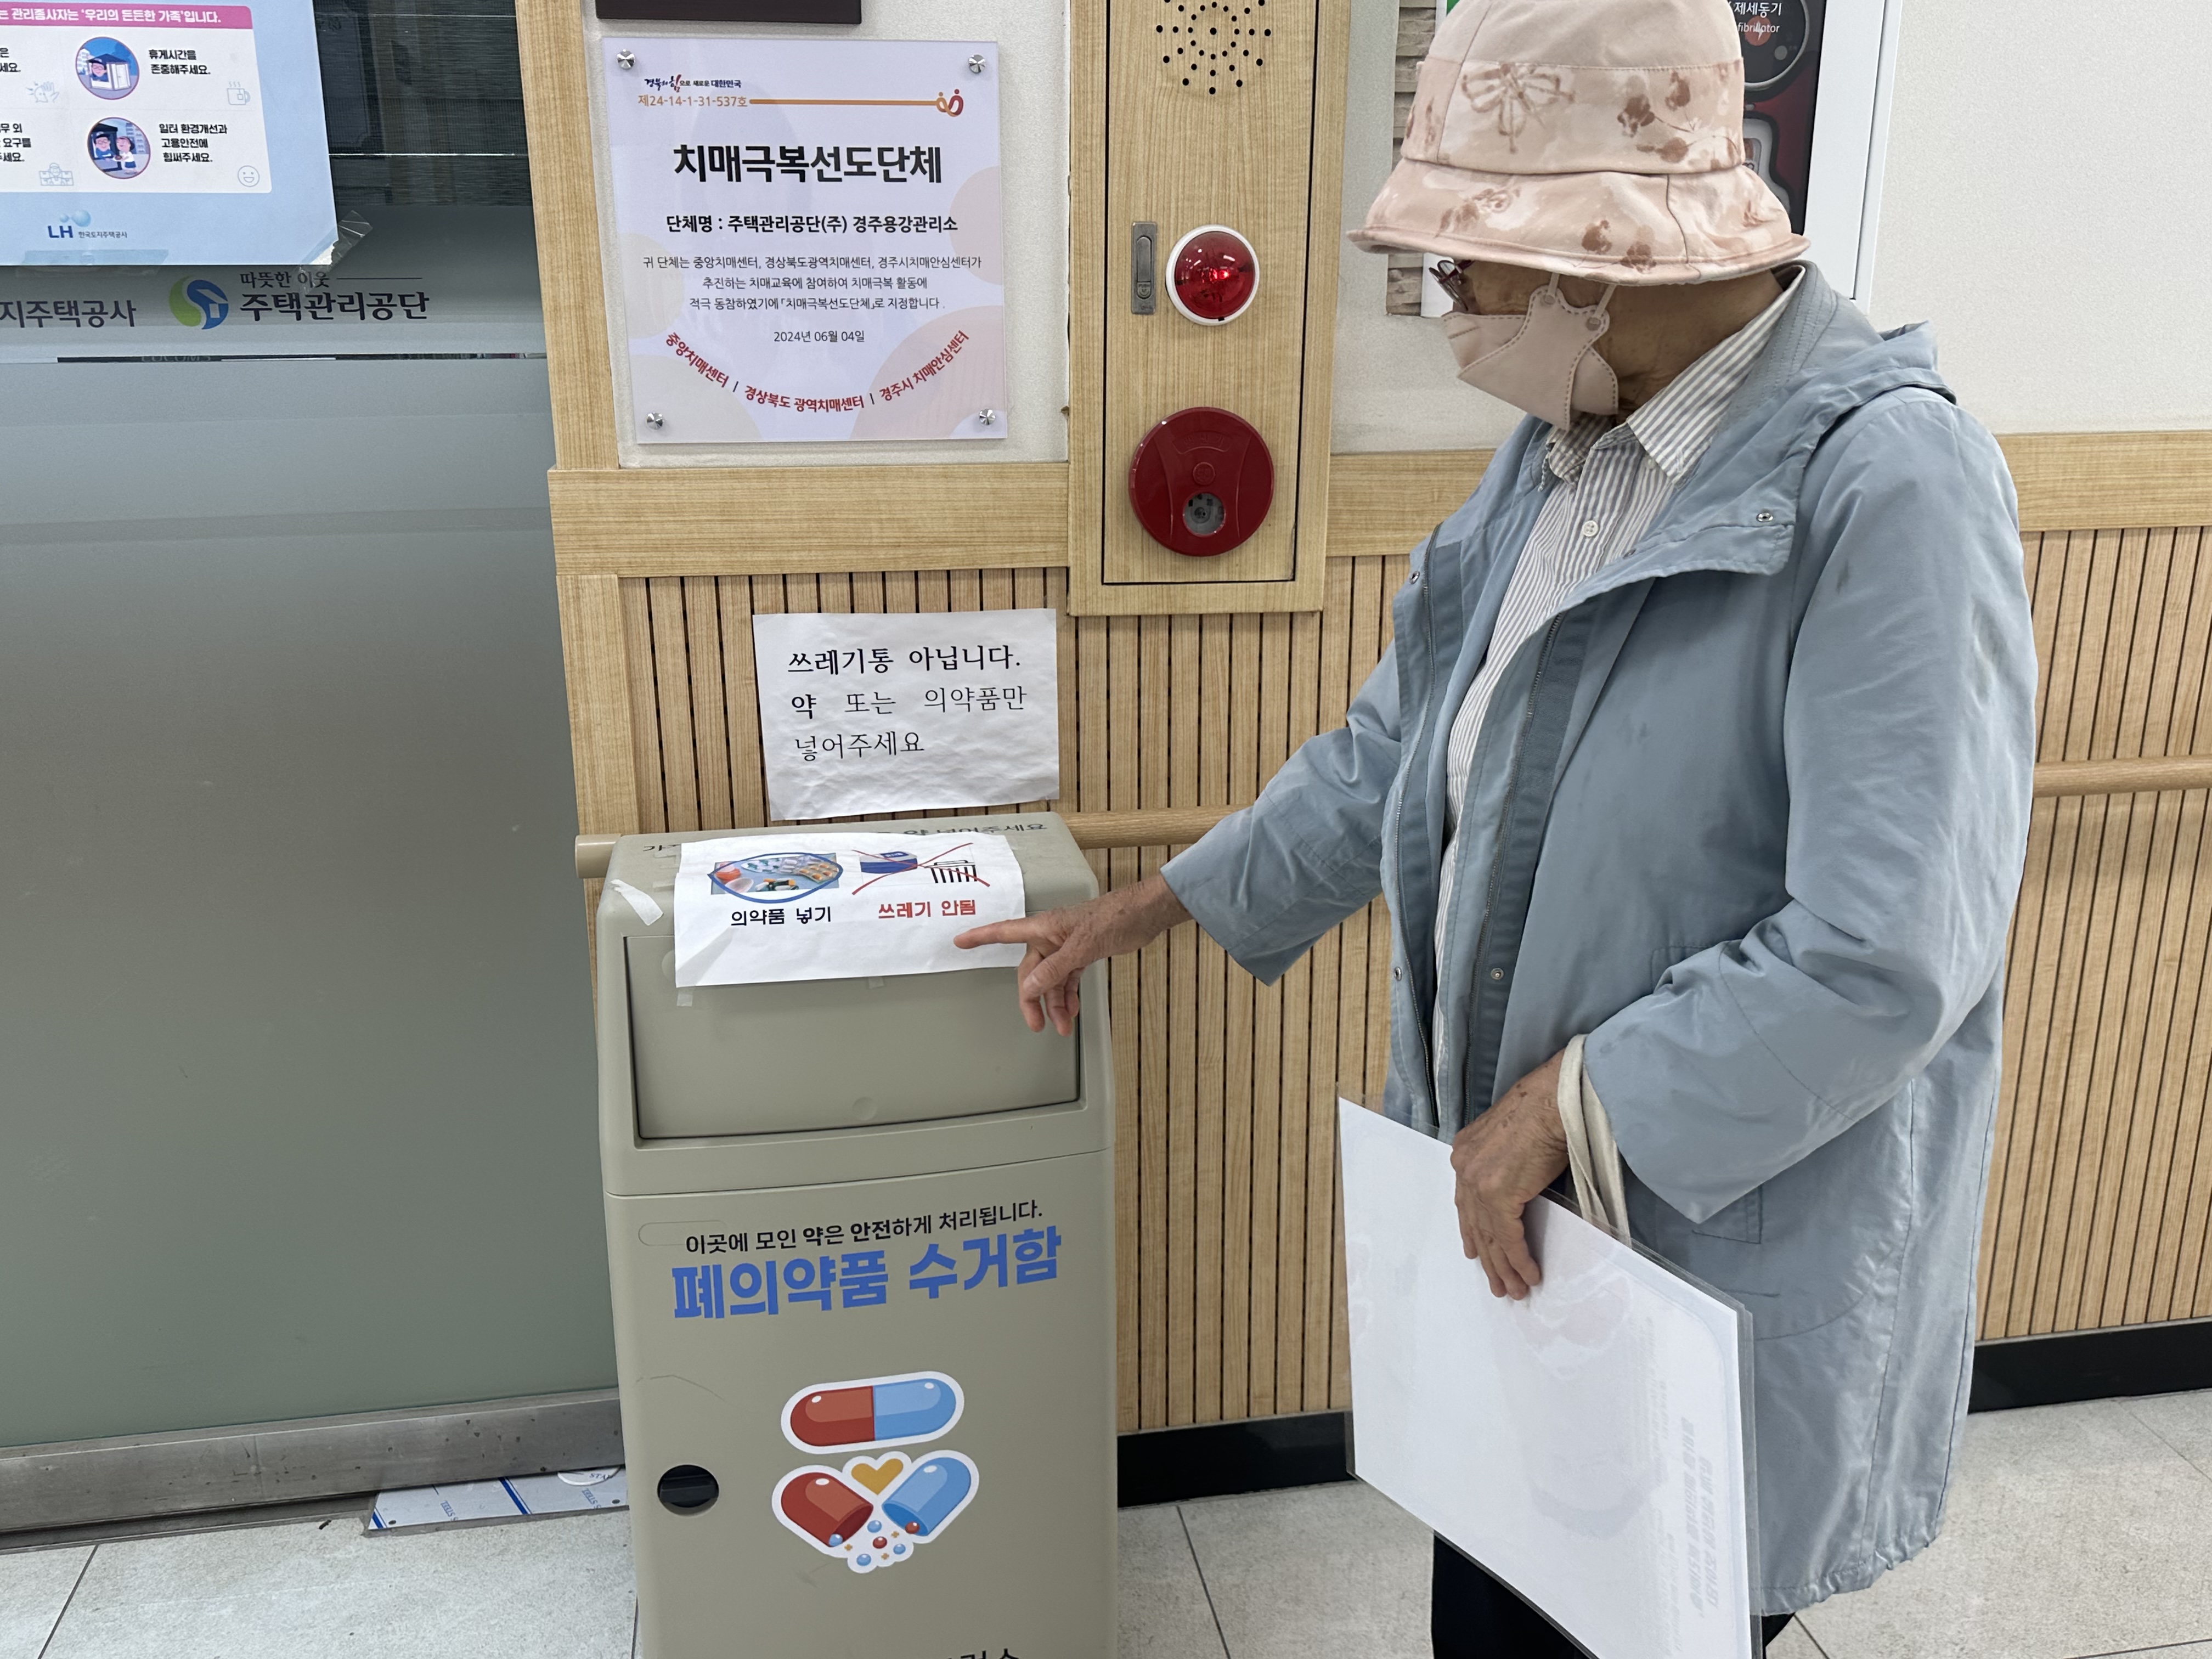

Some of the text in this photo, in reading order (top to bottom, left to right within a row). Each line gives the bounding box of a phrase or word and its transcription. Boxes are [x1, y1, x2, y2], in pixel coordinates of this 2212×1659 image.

[12, 8, 79, 21] 관리종사자는
[122, 10, 156, 22] 든든한
[1734, 2, 1782, 18] 제세동기
[149, 49, 197, 60] 휴게시간을
[151, 64, 211, 75] 존중해주세요.
[711, 80, 742, 88] 대한민국
[638, 94, 748, 107] 제24-14-1-31-537호
[13, 123, 22, 133] 외
[159, 123, 228, 134] 일터 환경개선과
[3, 138, 31, 148] 요구를
[161, 138, 208, 148] 고용안전에
[0, 153, 25, 162] 세요.
[163, 152, 213, 162] 힘써주세요.
[674, 144, 942, 183] 치매극복선도단체
[667, 215, 713, 234] 단체명
[727, 215, 848, 234] 주택관리공단(주)
[853, 215, 958, 234] 경주용강관리소
[47, 225, 74, 239] LH
[78, 231, 128, 239] 한국토지주택공사
[643, 256, 982, 269] 귀 단체는 중앙치매센터, 경상북도광역치매센터, 경주시치매안심센터가
[240, 272, 330, 289] 따뜻한 이웃
[703, 276, 927, 290] 추진하는 치매교육에 참여하여 치매극복 활동에
[240, 291, 430, 321] 주택관리공단
[690, 298, 712, 310] 적극
[0, 300, 137, 328] 지주택공사
[774, 330, 865, 343] 2024년 06월 04일
[665, 329, 969, 413] 중앙치매센터 경상북도 광역치매센터 경주시 치매안심센터
[788, 645, 1021, 675] 쓰레기통 아닙니다.
[791, 686, 1028, 719] 약 또는 의약품만
[795, 731, 925, 761] 넣어주세요
[878, 899, 977, 919] 쓰레기 안됨
[730, 906, 832, 927] 의약품 넣기
[686, 1199, 1043, 1255] 이곳에 모인 약은 안전하게 처리됩니다.
[672, 1226, 1062, 1319] 폐의약품 수거함
